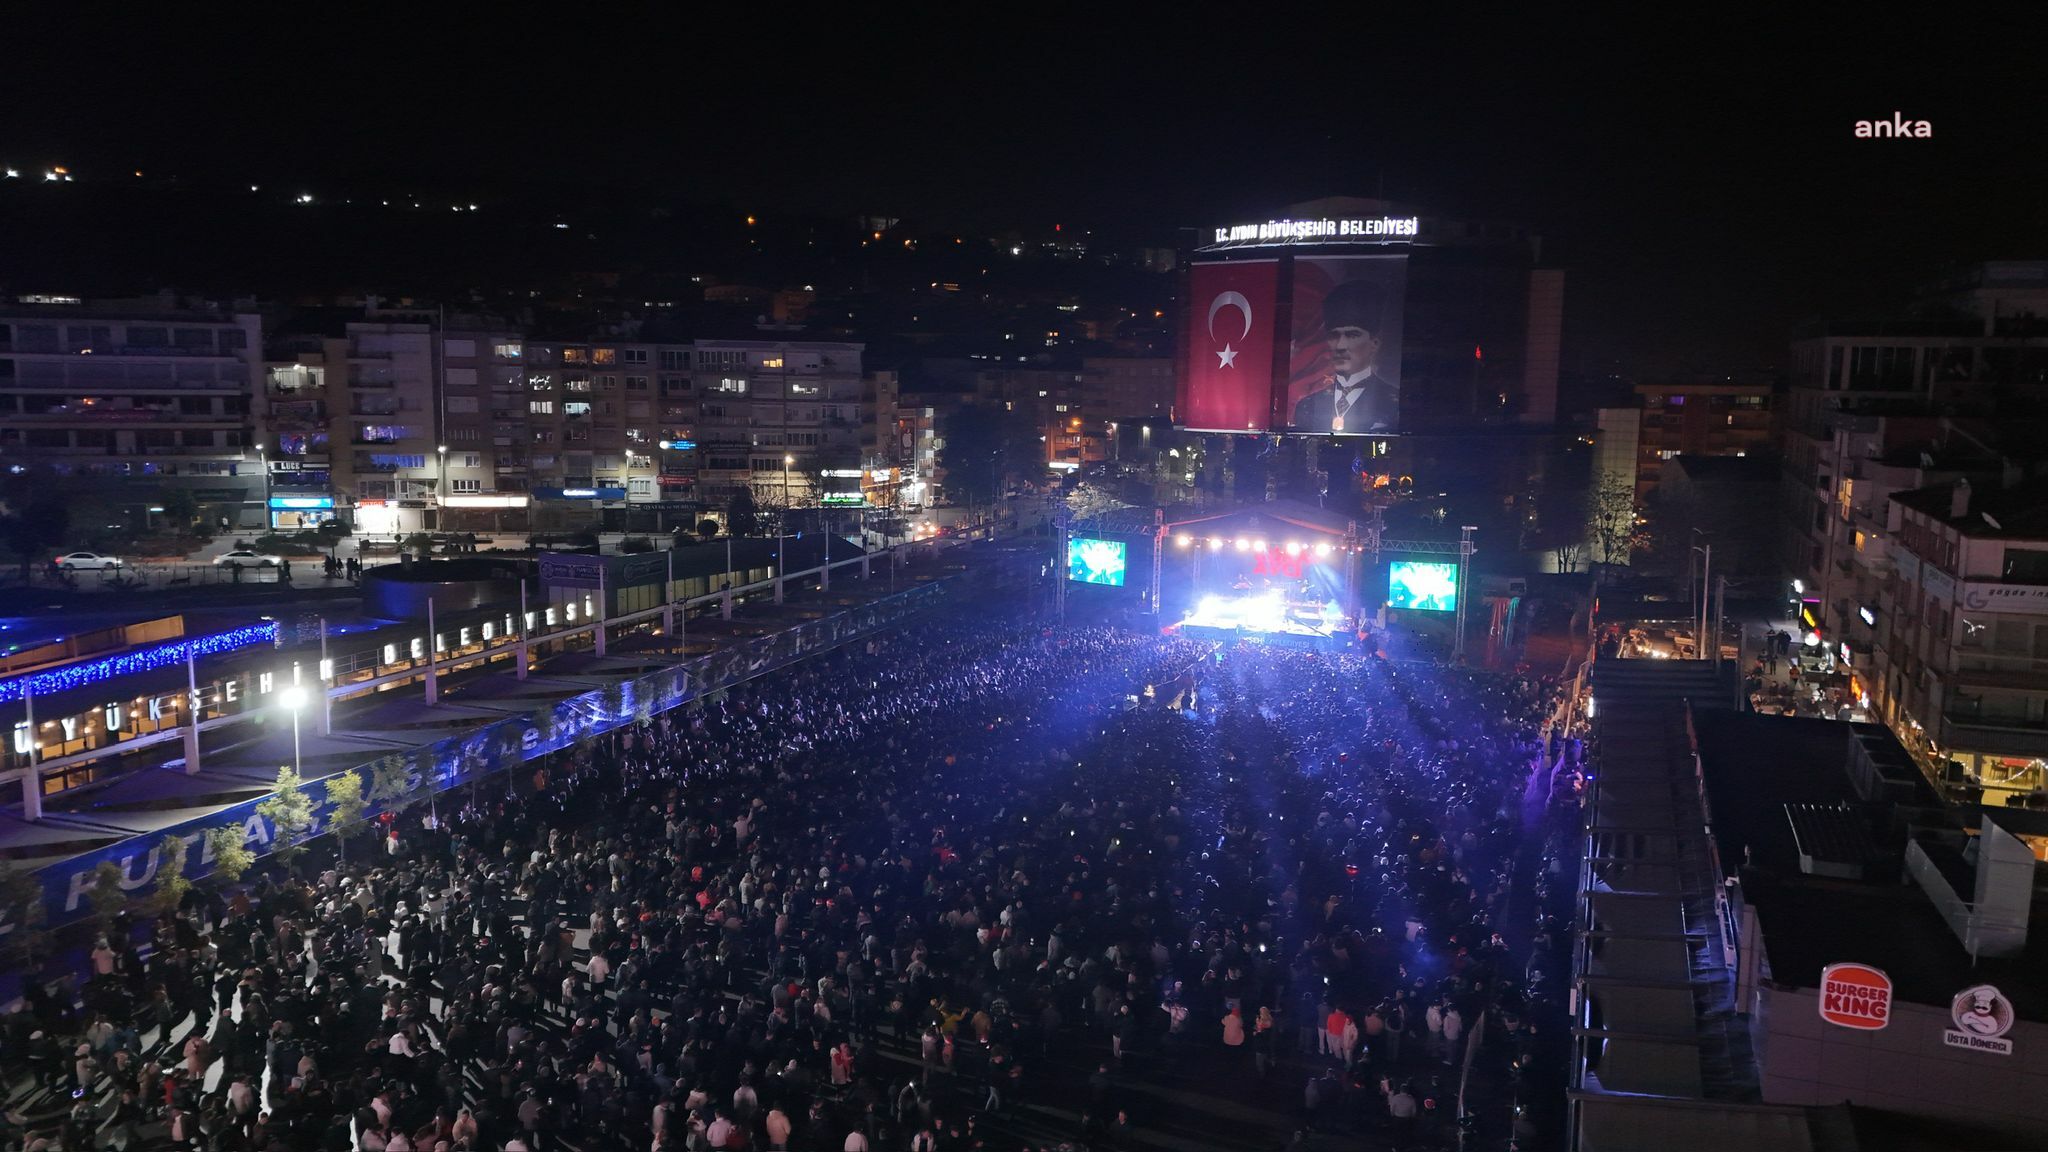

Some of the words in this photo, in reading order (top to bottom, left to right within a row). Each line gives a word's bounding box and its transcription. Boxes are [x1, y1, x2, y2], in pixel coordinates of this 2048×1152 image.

[1230, 224, 1258, 241] AYDIN
[1259, 218, 1336, 240] BÜYÜKŞEHİR
[1340, 216, 1417, 235] BELEDİYESİ
[384, 595, 593, 664] BELEDİYESİ
[1826, 982, 1888, 1002] BURGER
[1824, 993, 1887, 1018] KING
